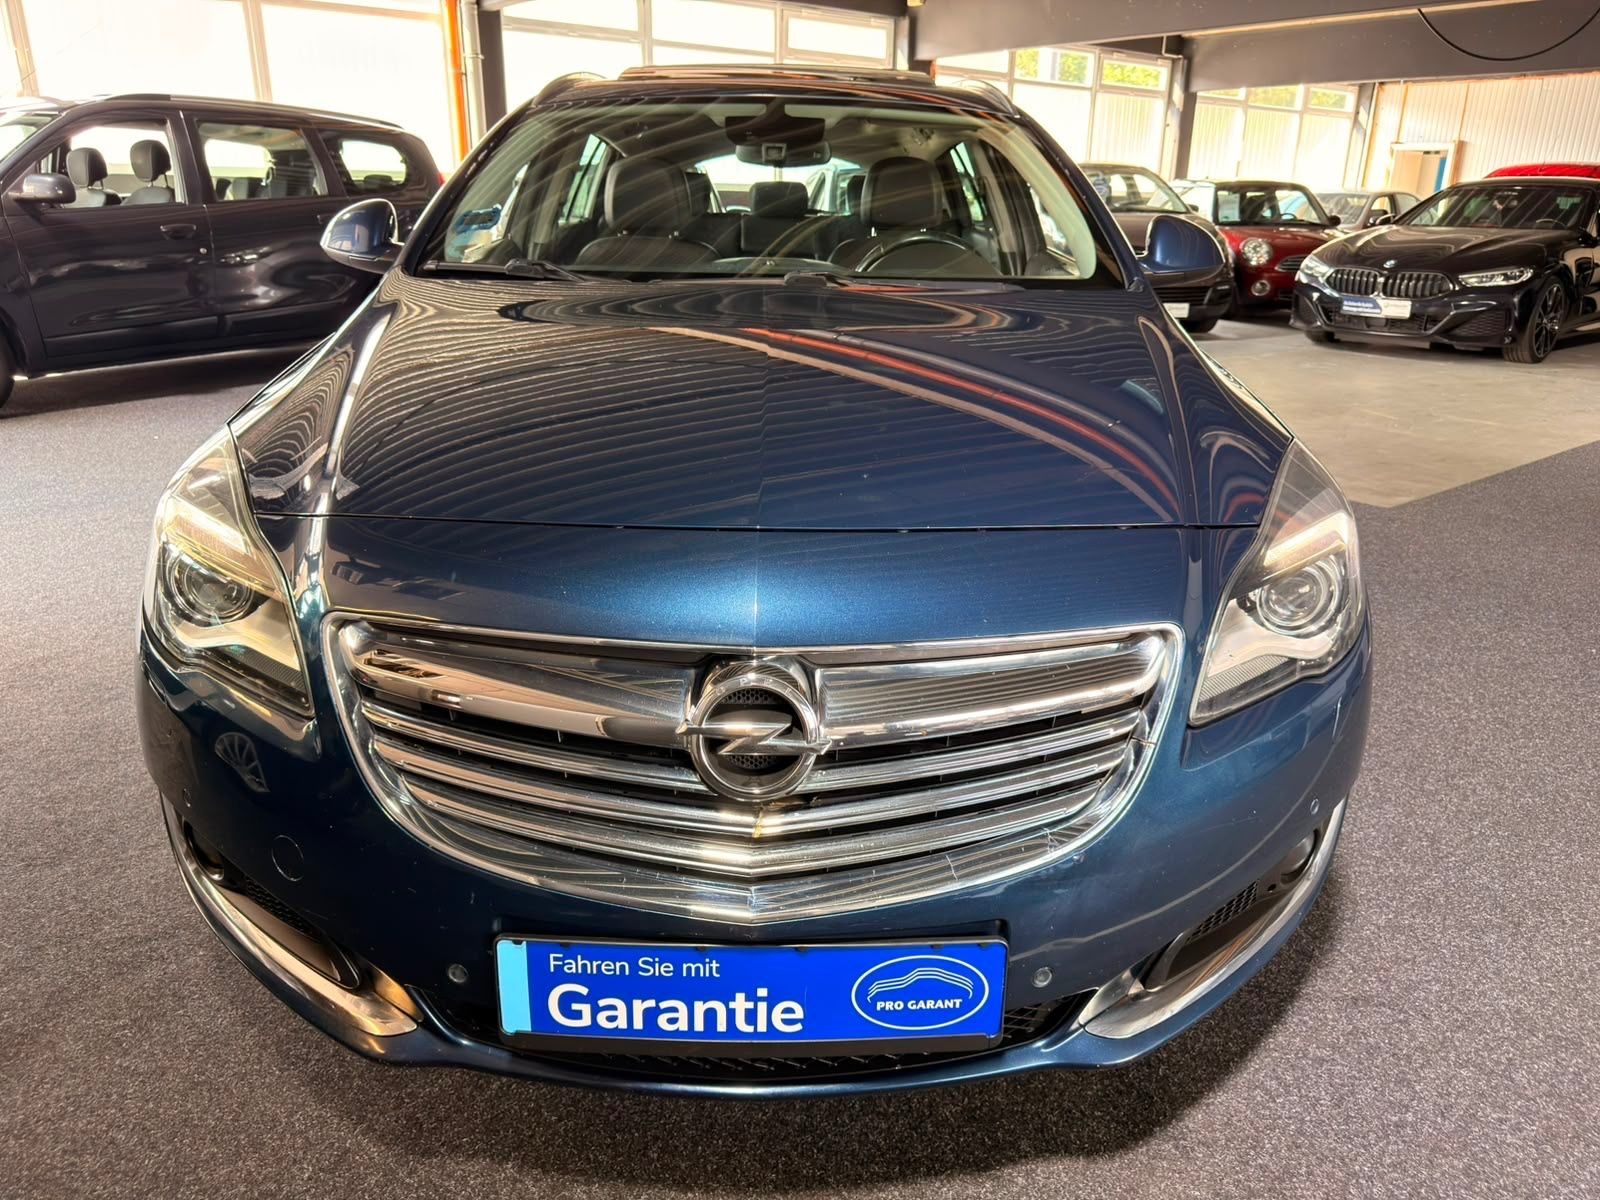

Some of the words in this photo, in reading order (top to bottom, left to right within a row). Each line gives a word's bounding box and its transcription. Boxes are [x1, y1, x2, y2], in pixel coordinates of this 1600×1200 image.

[549, 953, 630, 976] Fahren
[638, 956, 674, 977] Sie
[682, 957, 721, 978] mit
[547, 983, 805, 1033] Garantie
[876, 1000, 905, 1011] PRO
[907, 998, 963, 1010] GARANT
